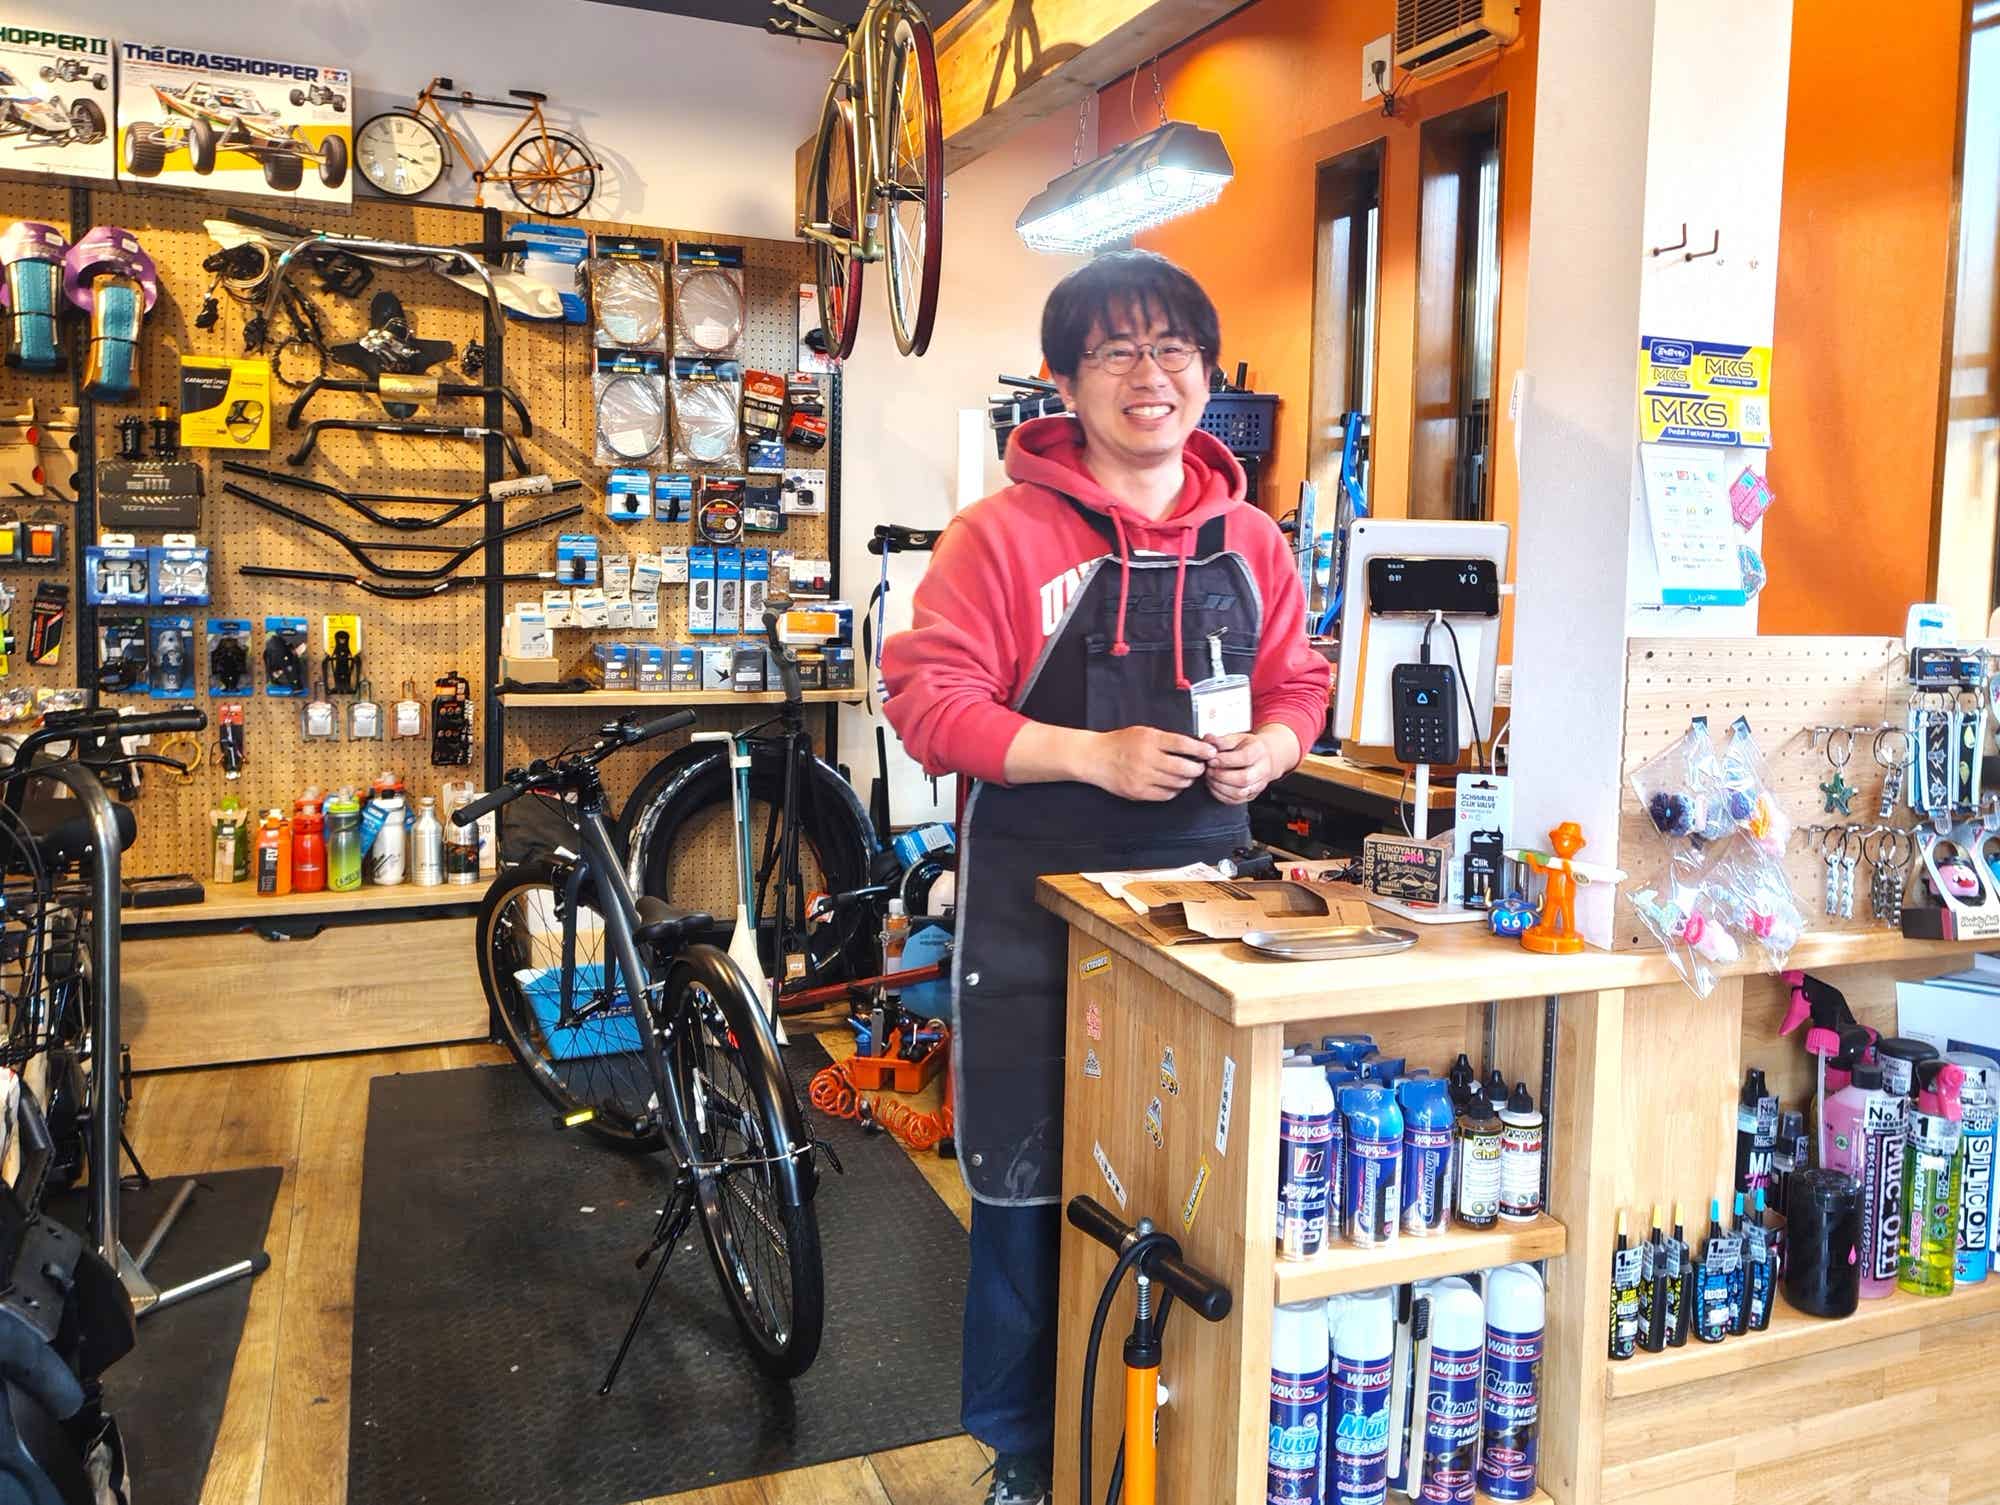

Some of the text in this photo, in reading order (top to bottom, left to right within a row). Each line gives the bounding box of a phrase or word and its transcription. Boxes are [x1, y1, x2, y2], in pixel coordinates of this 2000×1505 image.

[166, 49, 319, 82] GRASSHOPPER
[1705, 358, 1754, 378] MKS
[1651, 398, 1728, 428] MKS
[1376, 843, 1424, 856] SUKOYAKA
[1471, 857, 1489, 867] Clik
